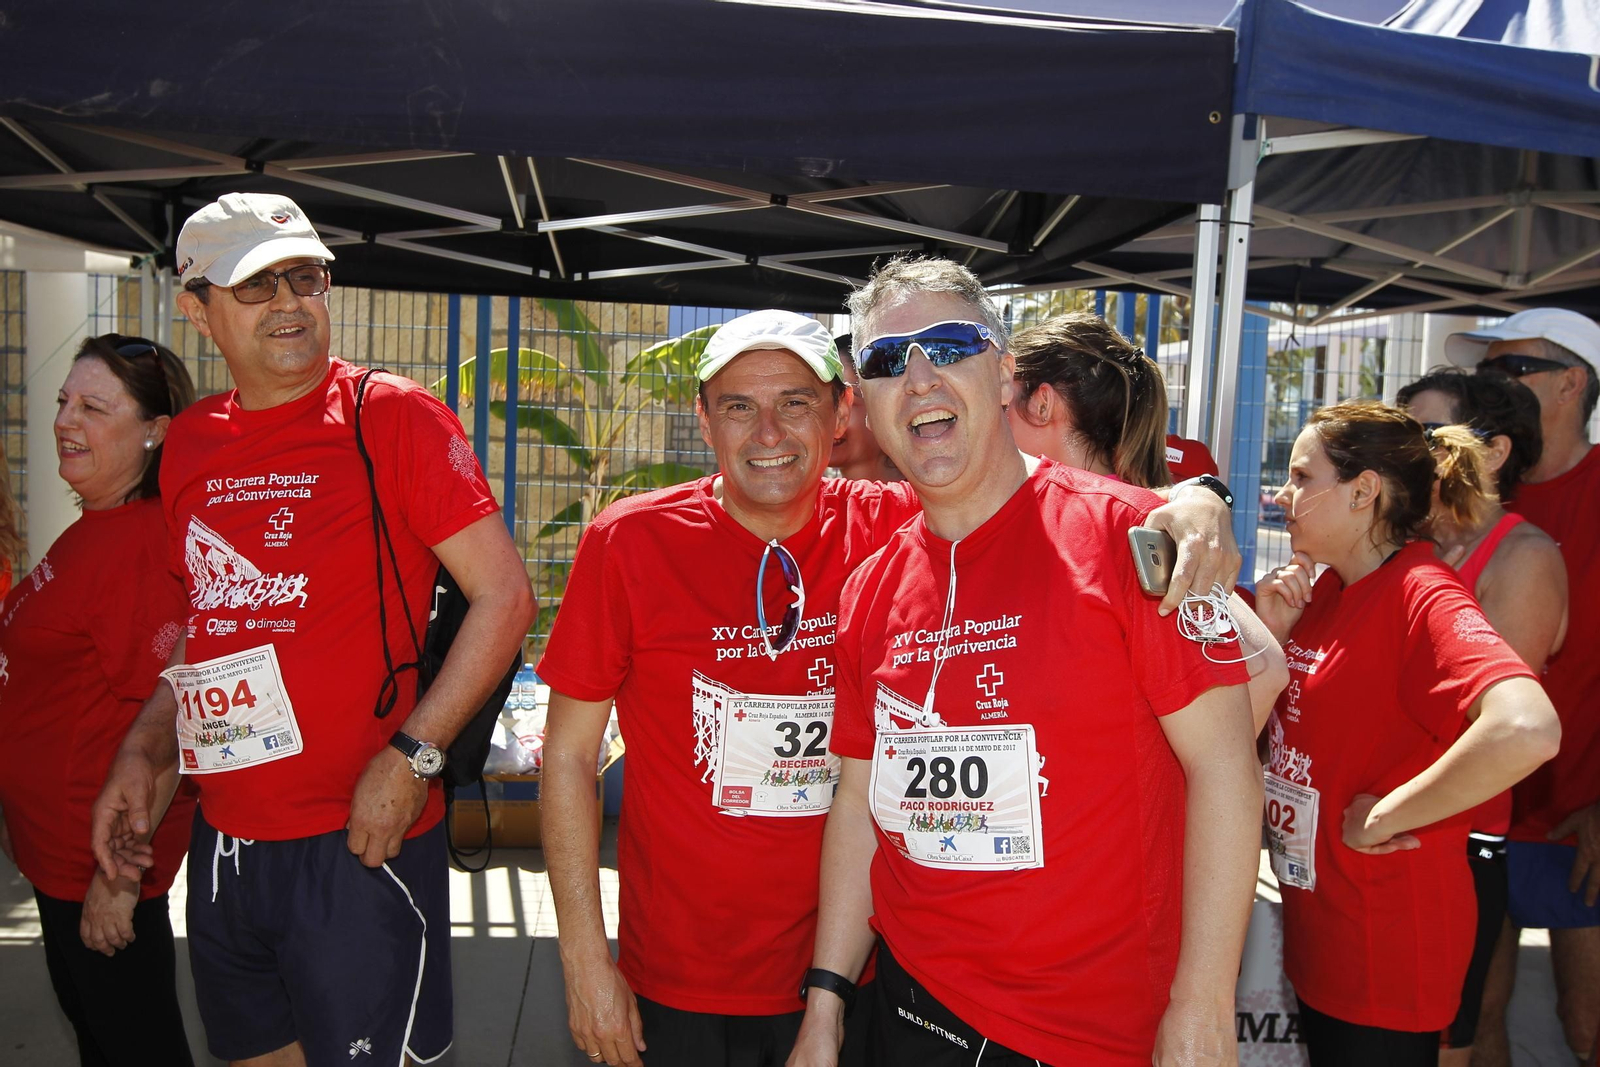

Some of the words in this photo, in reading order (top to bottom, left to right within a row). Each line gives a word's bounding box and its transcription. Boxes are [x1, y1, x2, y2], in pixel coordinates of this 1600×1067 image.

[206, 479, 222, 492] XV
[226, 476, 266, 490] Carrera
[268, 472, 320, 487] Popular
[206, 494, 225, 507] por
[224, 492, 234, 502] la
[236, 486, 312, 502] Convivencia
[264, 531, 278, 540] Cruz
[278, 531, 292, 541] Roja
[256, 618, 296, 628] dimoba
[712, 627, 738, 641] XV
[800, 612, 837, 632] opula
[892, 631, 914, 649] XV
[964, 614, 1022, 636] Popular
[716, 648, 744, 662] por
[747, 644, 758, 658] la
[758, 630, 836, 656] Civenci
[892, 651, 914, 669] por
[917, 648, 930, 662] la
[934, 634, 1018, 661] Convivencia
[222, 654, 266, 671] CONVIVENCIA
[219, 672, 226, 680] DE
[227, 668, 243, 678] MAYO
[244, 667, 252, 675] DE
[182, 678, 258, 720] 1194
[976, 700, 992, 710] Cruz
[992, 698, 1009, 710] Roja
[980, 711, 1008, 720] ALMERÍA
[774, 720, 828, 758] 32
[884, 736, 894, 745] XV
[894, 736, 918, 744] CARRERA
[918, 735, 944, 744] POPULAR
[944, 734, 960, 742] POR
[772, 758, 826, 769] ABECERRA
[904, 756, 988, 799] 280
[900, 801, 925, 812] PACO
[928, 800, 994, 812] RODRÍGUEZ
